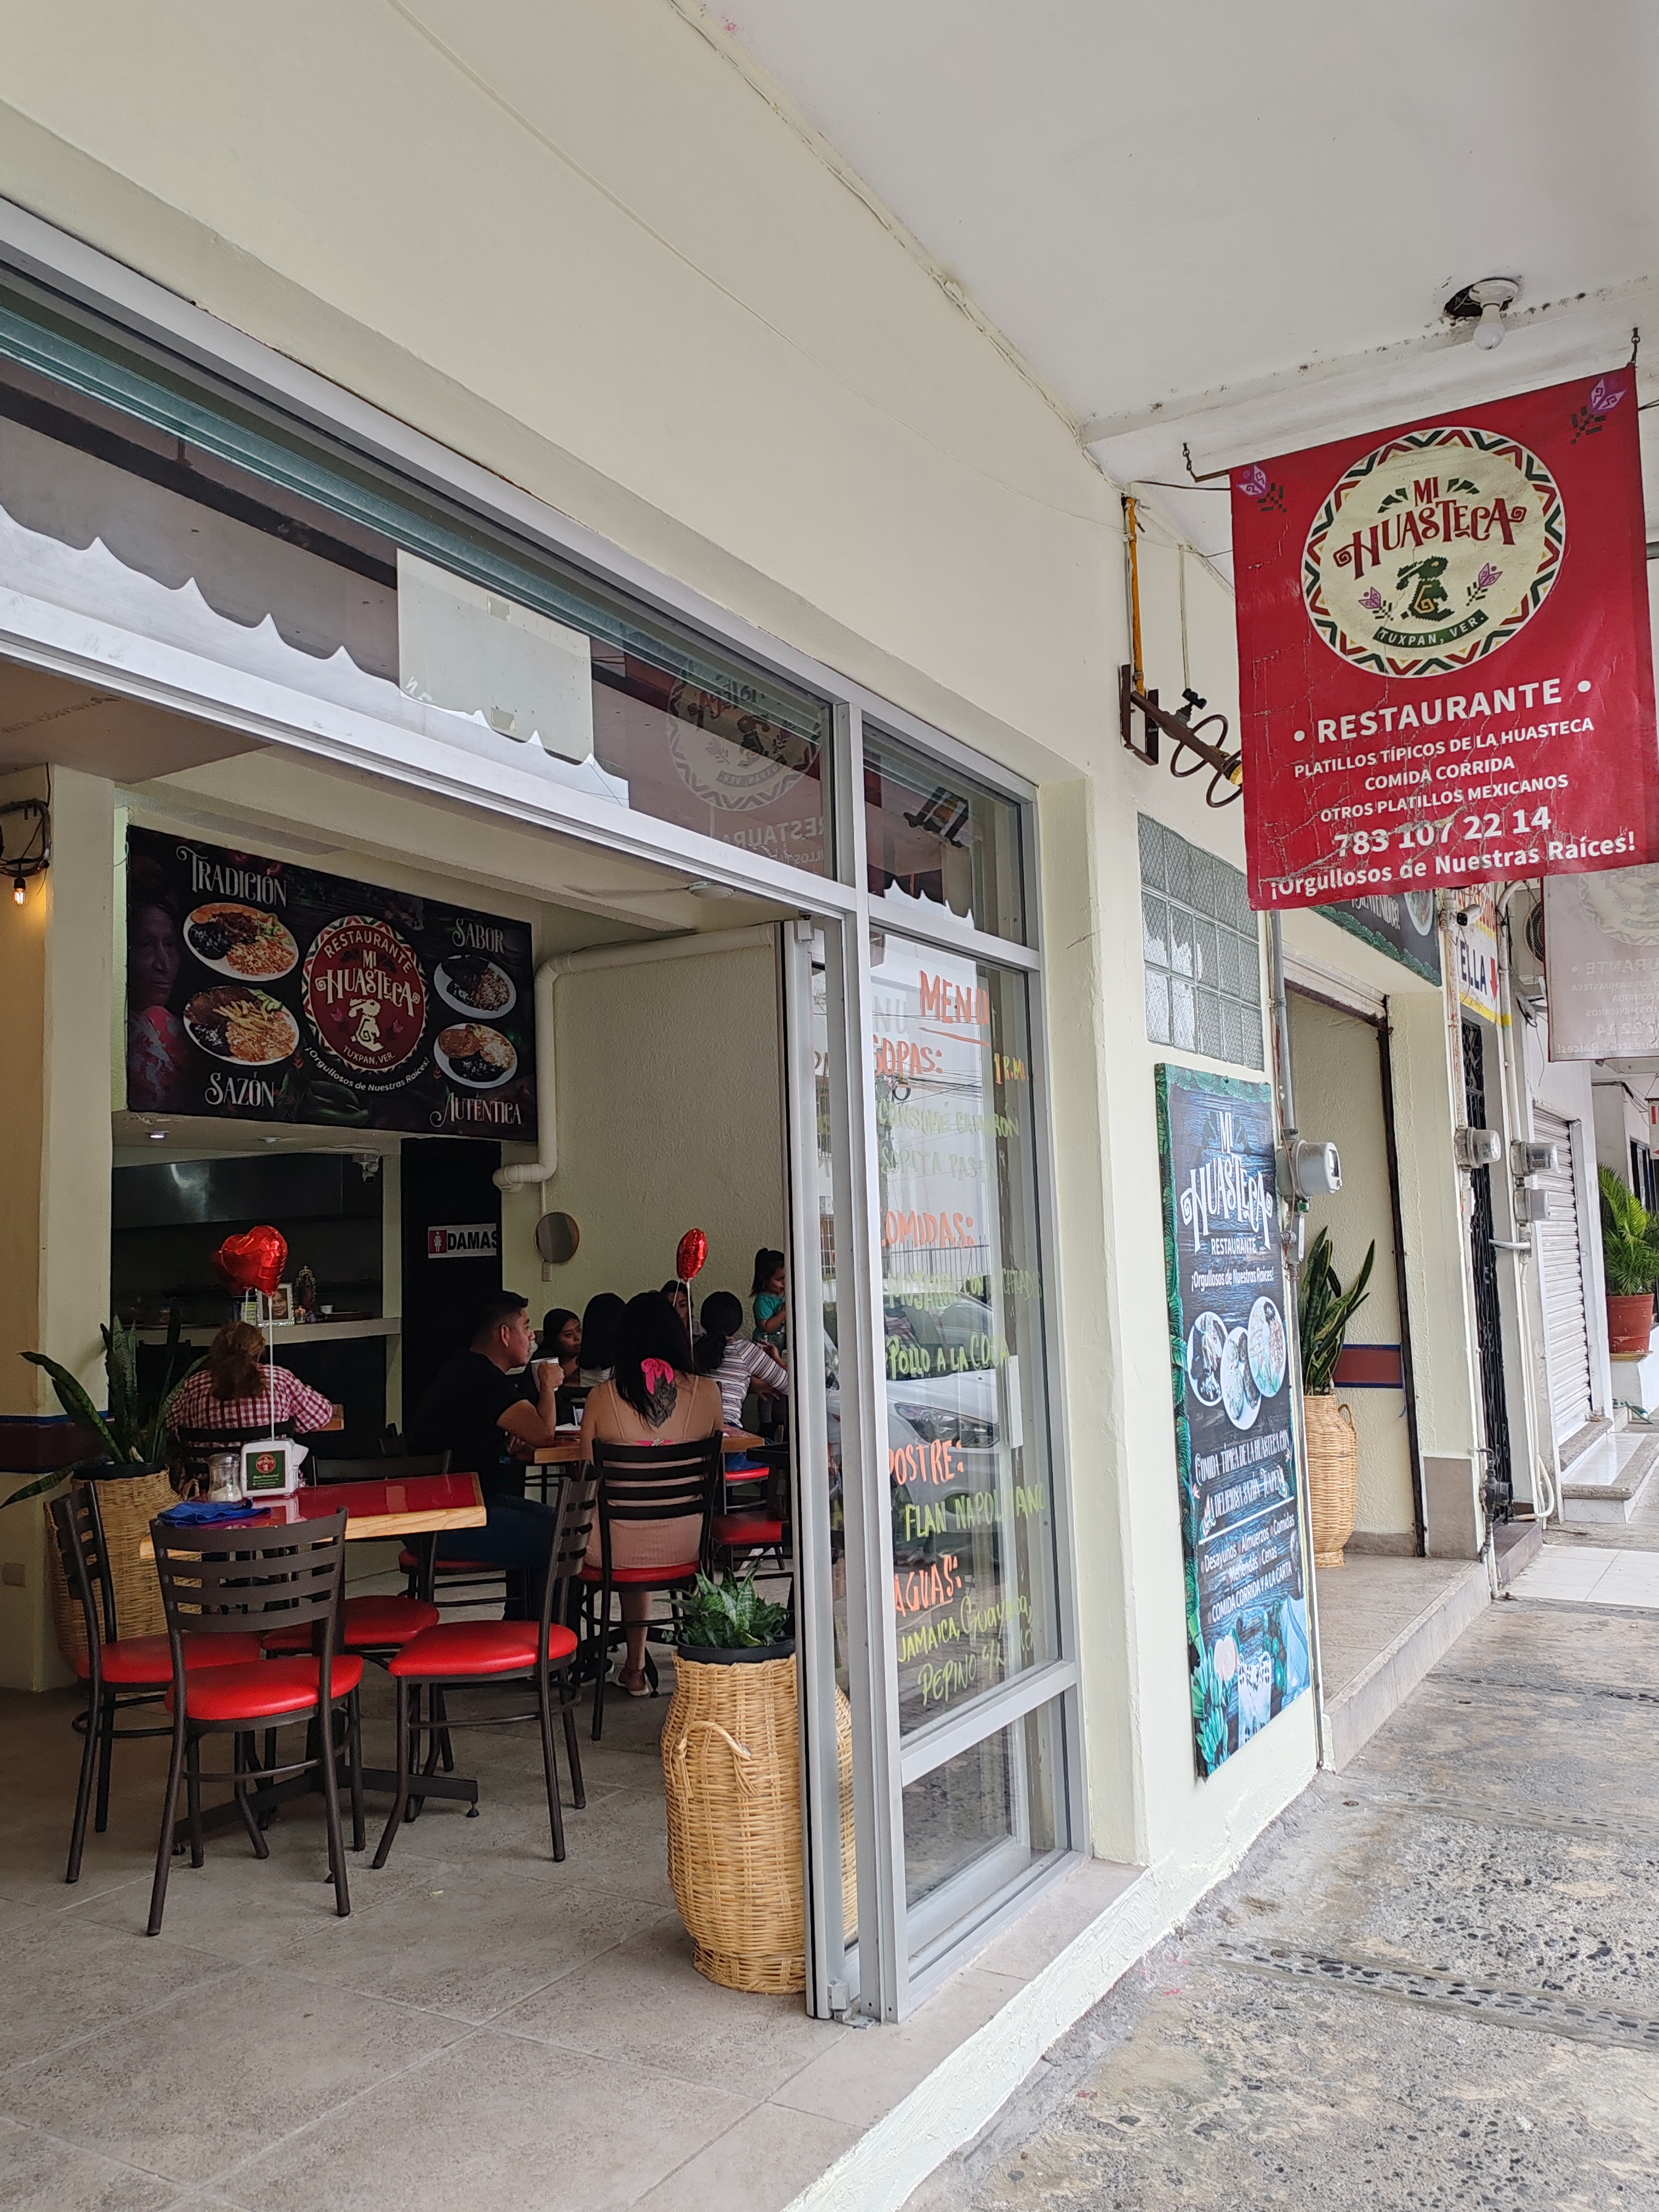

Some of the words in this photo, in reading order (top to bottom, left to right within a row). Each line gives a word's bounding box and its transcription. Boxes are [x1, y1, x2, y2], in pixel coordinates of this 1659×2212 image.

[1413, 476, 1440, 507] MI
[1333, 497, 1527, 581] HUASTECA
[1377, 629, 1445, 646] TUXPAN,
[1449, 616, 1485, 637] VER.
[1317, 678, 1562, 744] RESTAURANTE
[1294, 752, 1377, 778] PLATILLOS
[1379, 741, 1446, 763] TÍPICOS
[1449, 736, 1472, 753] DE
[1476, 733, 1498, 748] LA
[1501, 717, 1594, 745] HUASTECA
[1365, 769, 1433, 791] COMIDA
[1435, 755, 1515, 781] CORRIDA
[1320, 802, 1373, 823] OTROS
[1377, 789, 1464, 814] PLATILLOS
[1467, 773, 1569, 801] MEXICANOS
[1334, 828, 1390, 857] 783
[1397, 821, 1455, 849] 107
[1463, 813, 1503, 841] 22
[1513, 806, 1552, 834] 14
[176, 845, 286, 908] TRADICIÓN
[1271, 865, 1392, 900] ¡Orgullosos
[1400, 858, 1427, 880] de
[1435, 847, 1539, 875] Nuestras
[1549, 831, 1636, 861] Raíces!
[324, 930, 413, 974] RESTAURANTE
[452, 918, 505, 954] SABOR
[362, 949, 377, 969] MI
[1459, 939, 1488, 996] ELLA
[315, 967, 421, 1018] HUASTECA
[919, 969, 990, 1025] MENU
[304, 1047, 354, 1087] ¡Orgullosos
[354, 1082, 366, 1091] de
[367, 1079, 405, 1092] Nuestras
[406, 1056, 431, 1084] Raíces!
[343, 1045, 378, 1065] TUXPAN,
[378, 1052, 396, 1064] VER.
[205, 1071, 275, 1108] SAZÓN
[429, 1091, 522, 1128] AUTÉNTICA
[1219, 1110, 1233, 1154] MI
[1179, 1152, 1273, 1254] HUASTECA
[447, 1230, 497, 1250] DAMAS
[880, 1209, 975, 1248] OMIDAS:
[1211, 1237, 1257, 1256] RESTAURANTE
[1191, 1269, 1225, 1293] ¡Orgullosos
[1225, 1268, 1232, 1286] de
[1232, 1268, 1256, 1285] Nuestras
[1256, 1265, 1274, 1283] Raíces!
[886, 1334, 930, 1380] POLLO
[937, 1347, 947, 1372] A
[950, 1346, 969, 1372] LA
[1195, 1452, 1220, 1486] COMIDA
[905, 1500, 948, 1543] FLAN
[955, 1481, 1047, 1530] NAPOLANO
[1204, 1543, 1237, 1573] Desayunos
[1242, 1527, 1269, 1552] Almuerzos
[1273, 1511, 1295, 1536] Comidas
[1228, 1554, 1258, 1583] Meriendas
[1261, 1545, 1277, 1565] Cenas
[1212, 1594, 1236, 1623] COMIDA
[1236, 1578, 1261, 1608] CORRIDA
[1260, 1576, 1264, 1592] Y
[1268, 1570, 1276, 1588] LA
[1276, 1560, 1293, 1583] CARTA
[897, 1616, 961, 1663] JAMAICA,
[918, 1653, 977, 1707] PEPINO
